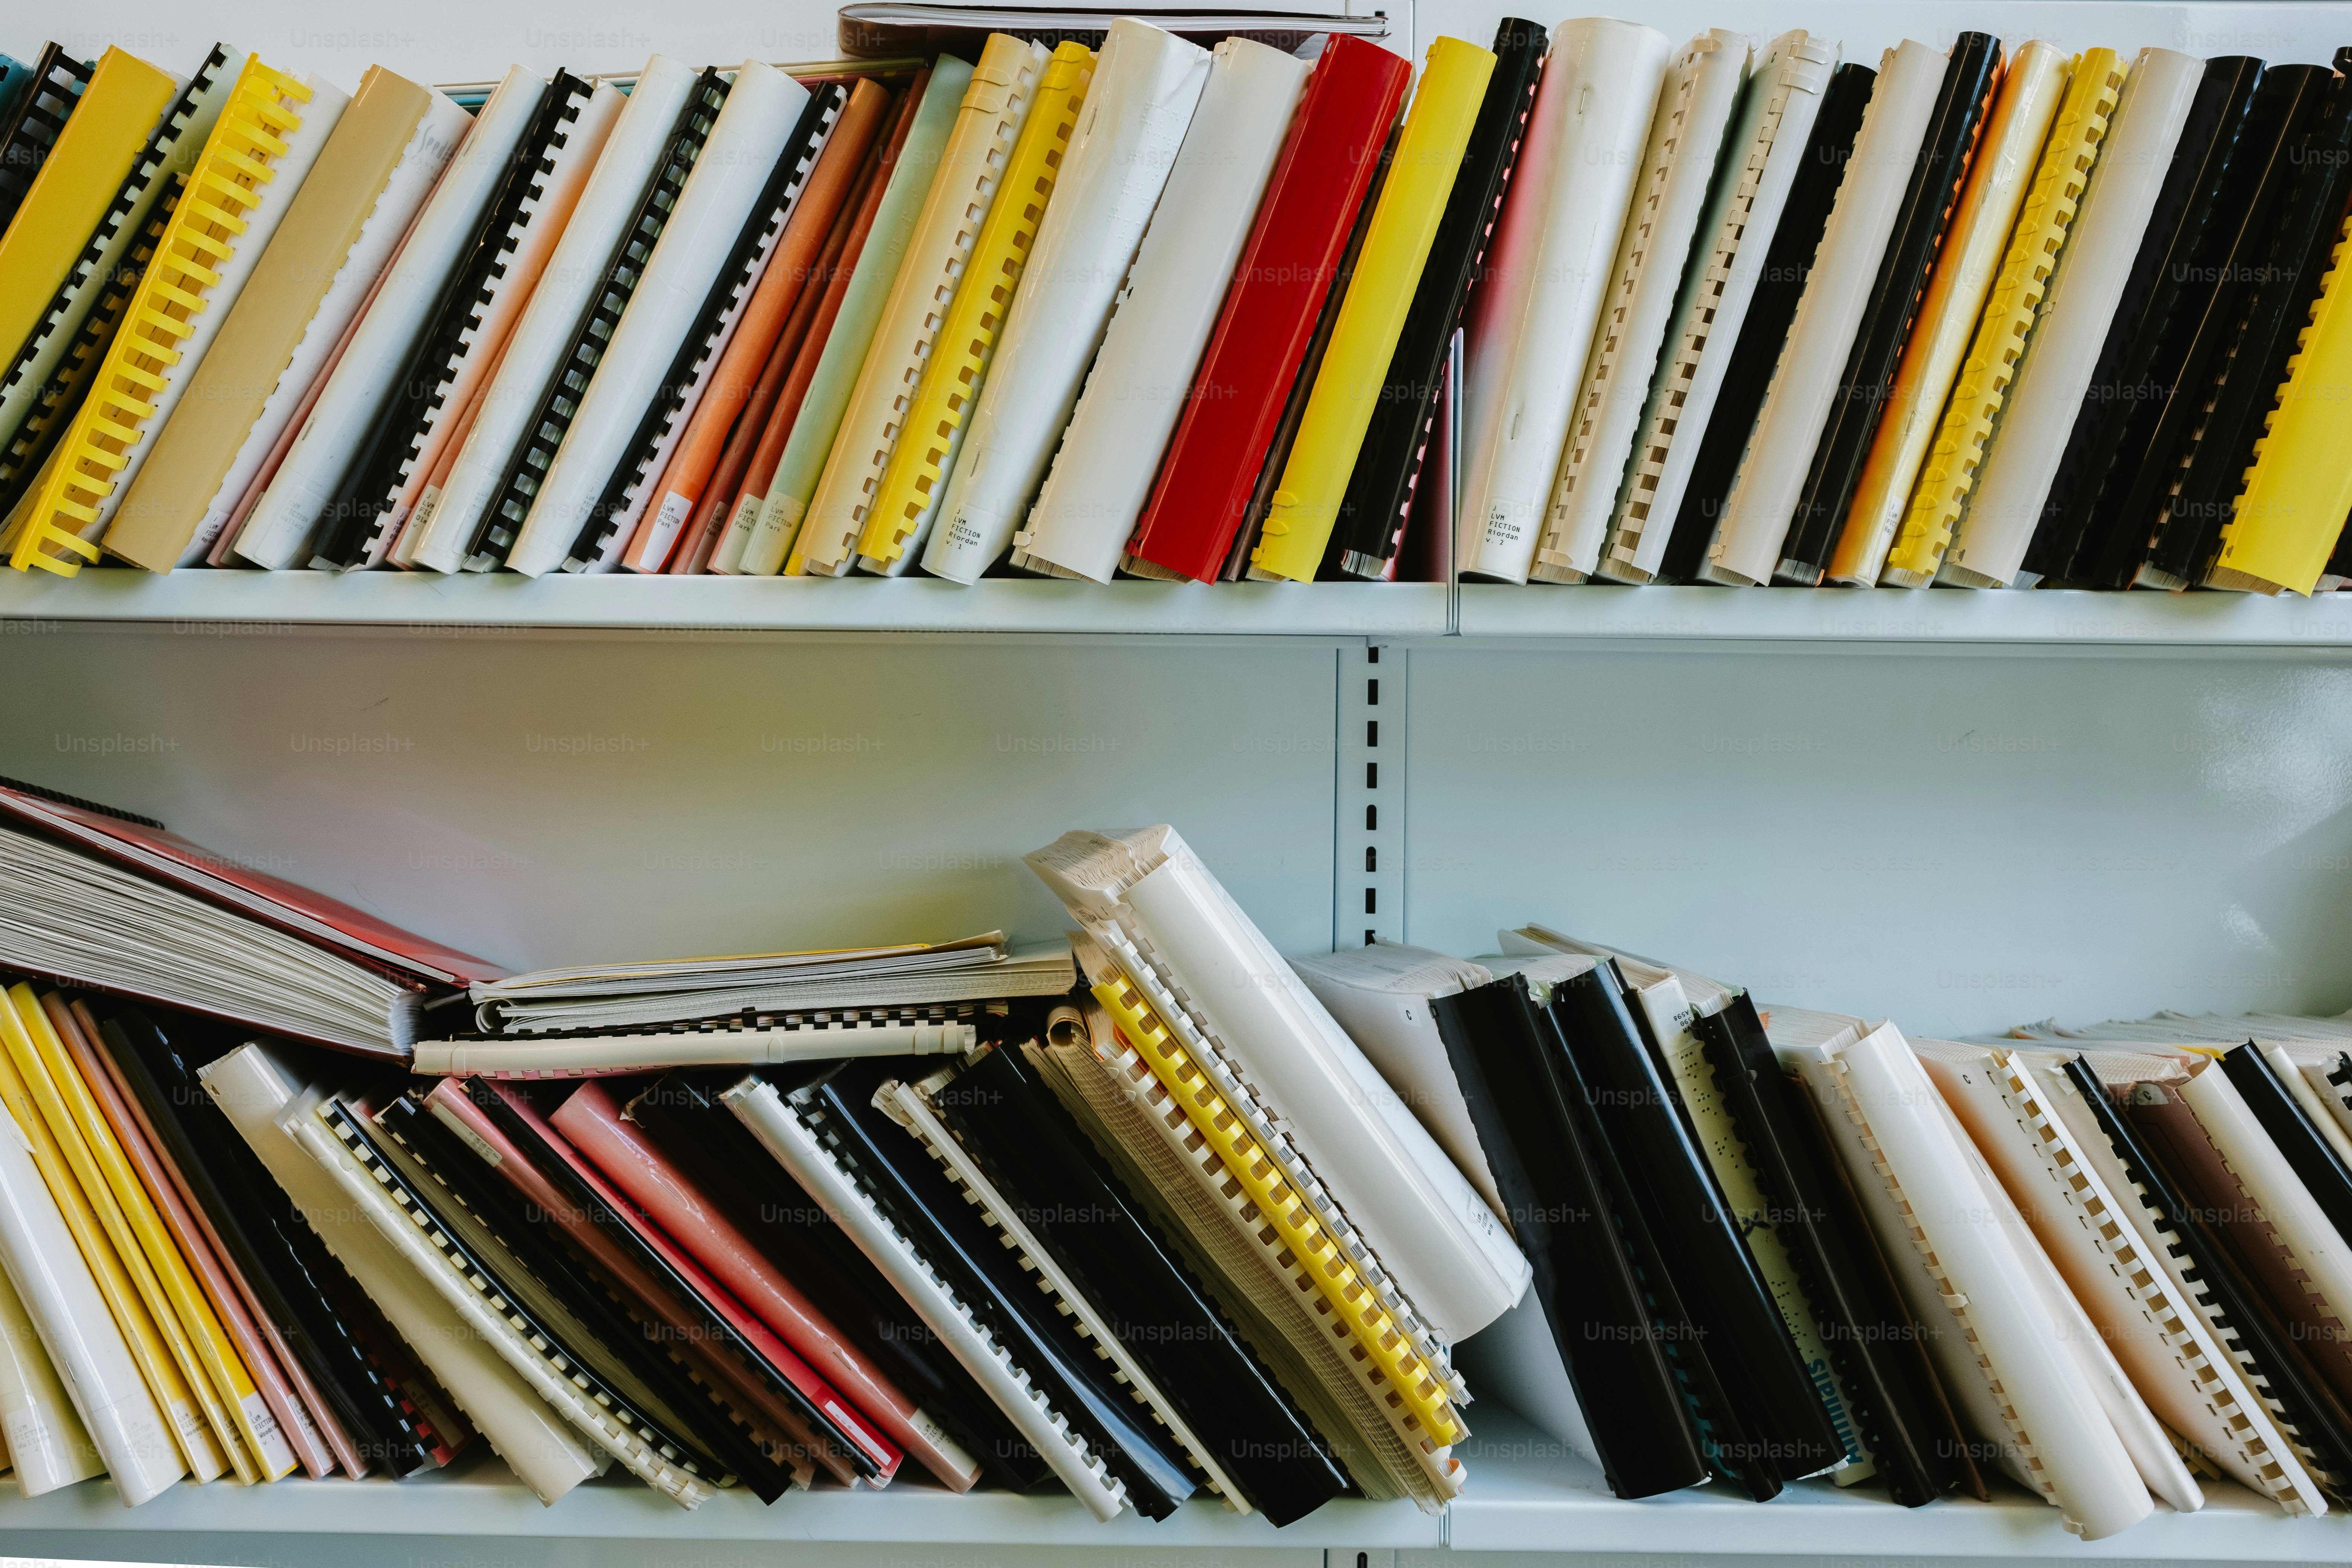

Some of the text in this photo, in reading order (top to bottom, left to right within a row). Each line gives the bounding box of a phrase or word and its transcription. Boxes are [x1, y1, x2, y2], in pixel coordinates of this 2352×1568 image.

[1771, 52, 1777, 63] C
[1679, 58, 1684, 69] C
[423, 500, 435, 509] LVM
[663, 504, 675, 513] LVM
[741, 507, 754, 516] LVM
[771, 507, 784, 516] LVM
[657, 518, 670, 528] Park
[660, 511, 680, 524] FICTION
[769, 514, 793, 528] FICTION
[954, 516, 966, 525] LVM
[735, 521, 750, 533] Park
[766, 522, 781, 533] Park
[951, 524, 981, 539] FICTION
[1489, 521, 1520, 533] FICTION
[949, 531, 978, 546] Riordan
[1487, 529, 1518, 541] Riordan
[1406, 1010, 1412, 1020] C
[1674, 1009, 1689, 1021] A598
[1680, 1017, 1692, 1026] 590
[1963, 1075, 1971, 1084] C
[2142, 1090, 2152, 1101] C
[1805, 1358, 1864, 1464] Animals
[178, 1413, 190, 1423] LVM
[181, 1414, 202, 1430] FICTION
[251, 1415, 261, 1424] LVM
[255, 1417, 272, 1431] FICTION
[922, 1424, 931, 1436] LVM
